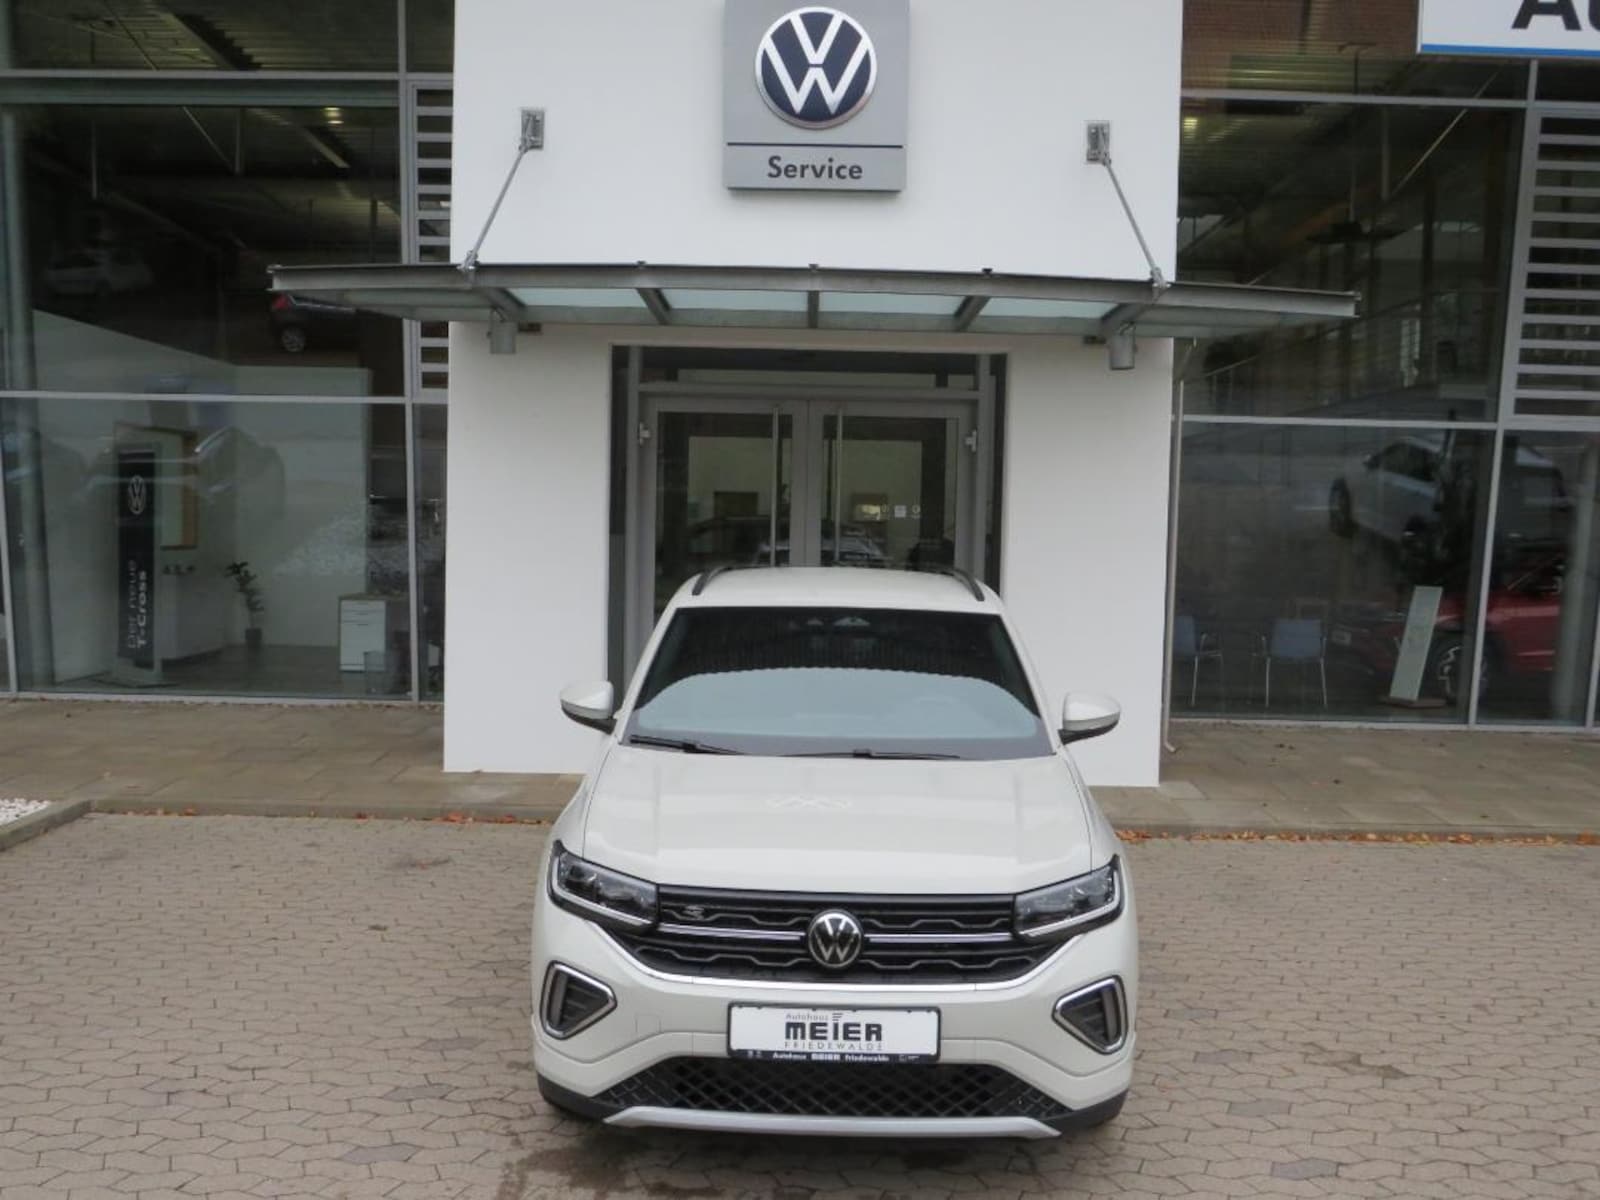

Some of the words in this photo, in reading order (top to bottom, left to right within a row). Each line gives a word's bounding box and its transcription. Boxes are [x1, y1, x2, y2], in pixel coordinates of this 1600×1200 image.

[756, 7, 876, 129] VW
[767, 155, 863, 180] Service
[137, 571, 147, 649] T-Cross
